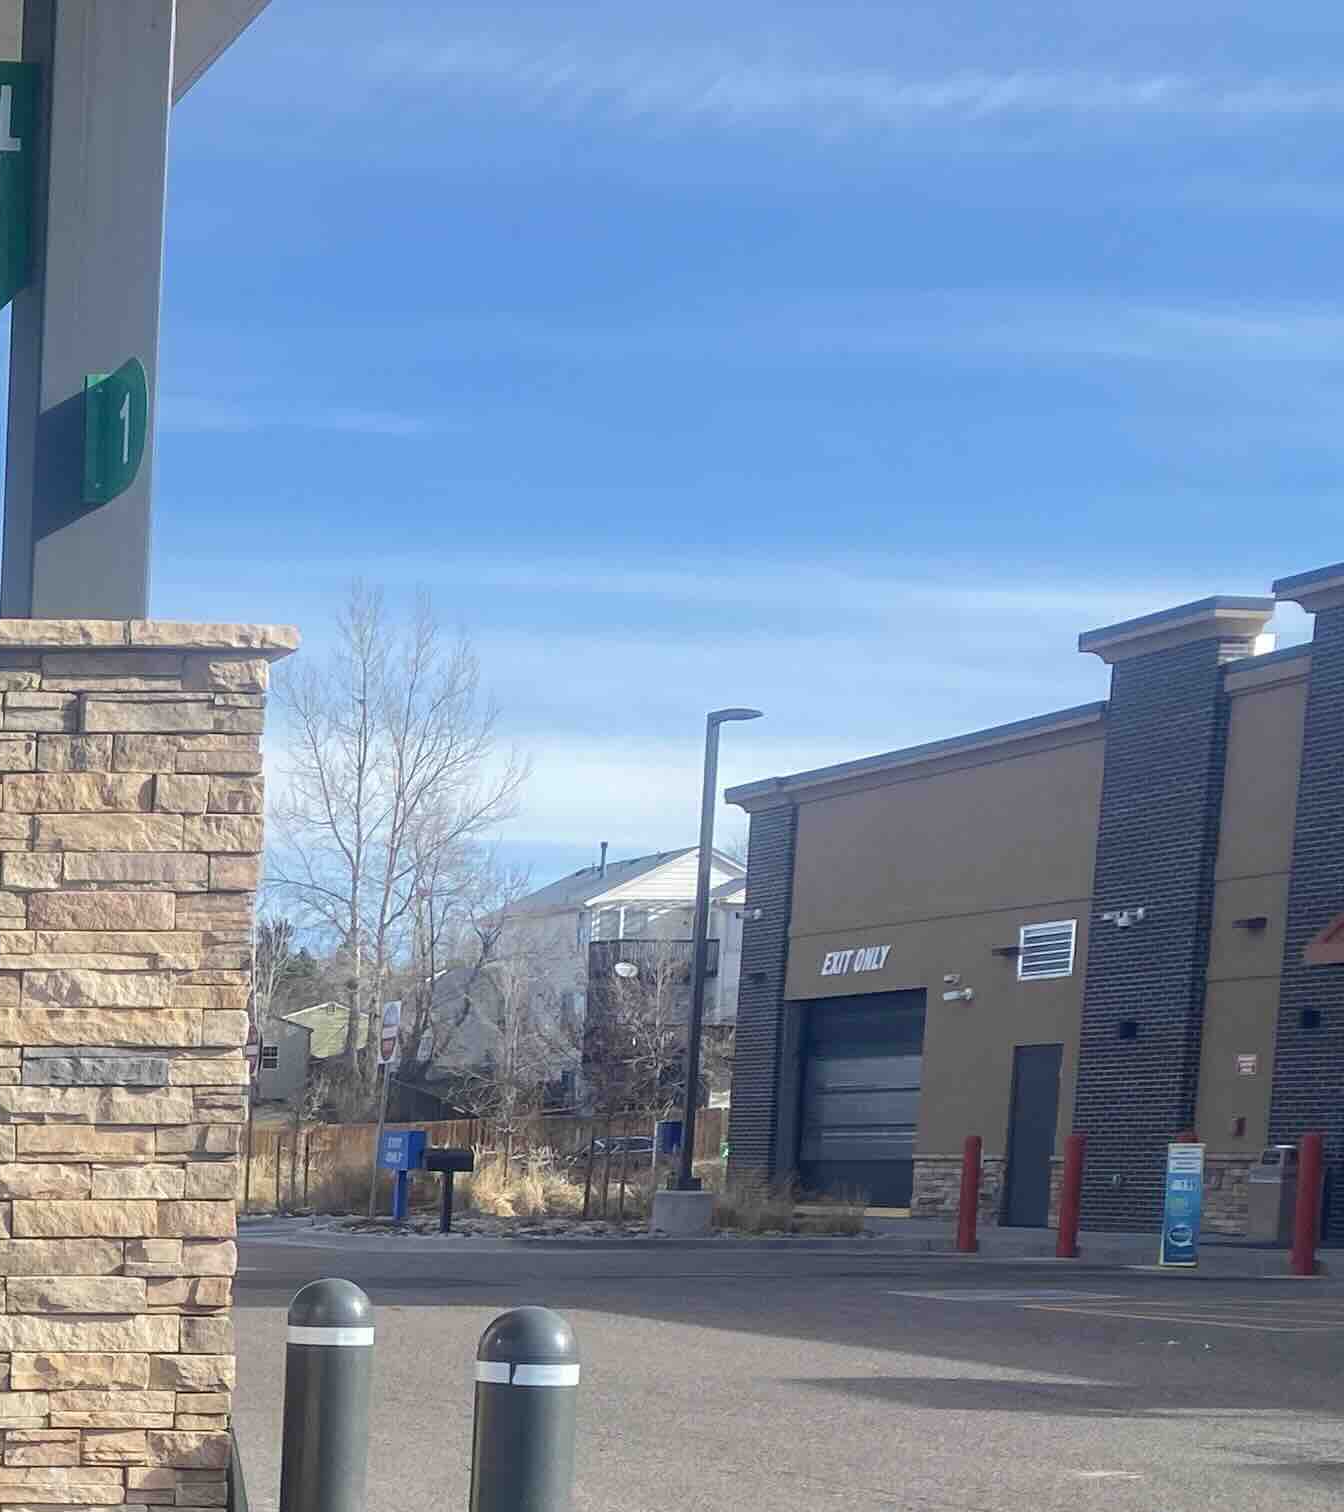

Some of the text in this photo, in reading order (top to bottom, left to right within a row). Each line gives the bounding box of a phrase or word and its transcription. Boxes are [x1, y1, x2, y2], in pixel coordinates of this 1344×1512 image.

[119, 391, 131, 465] 1
[820, 944, 892, 976] EXIT ONLY
